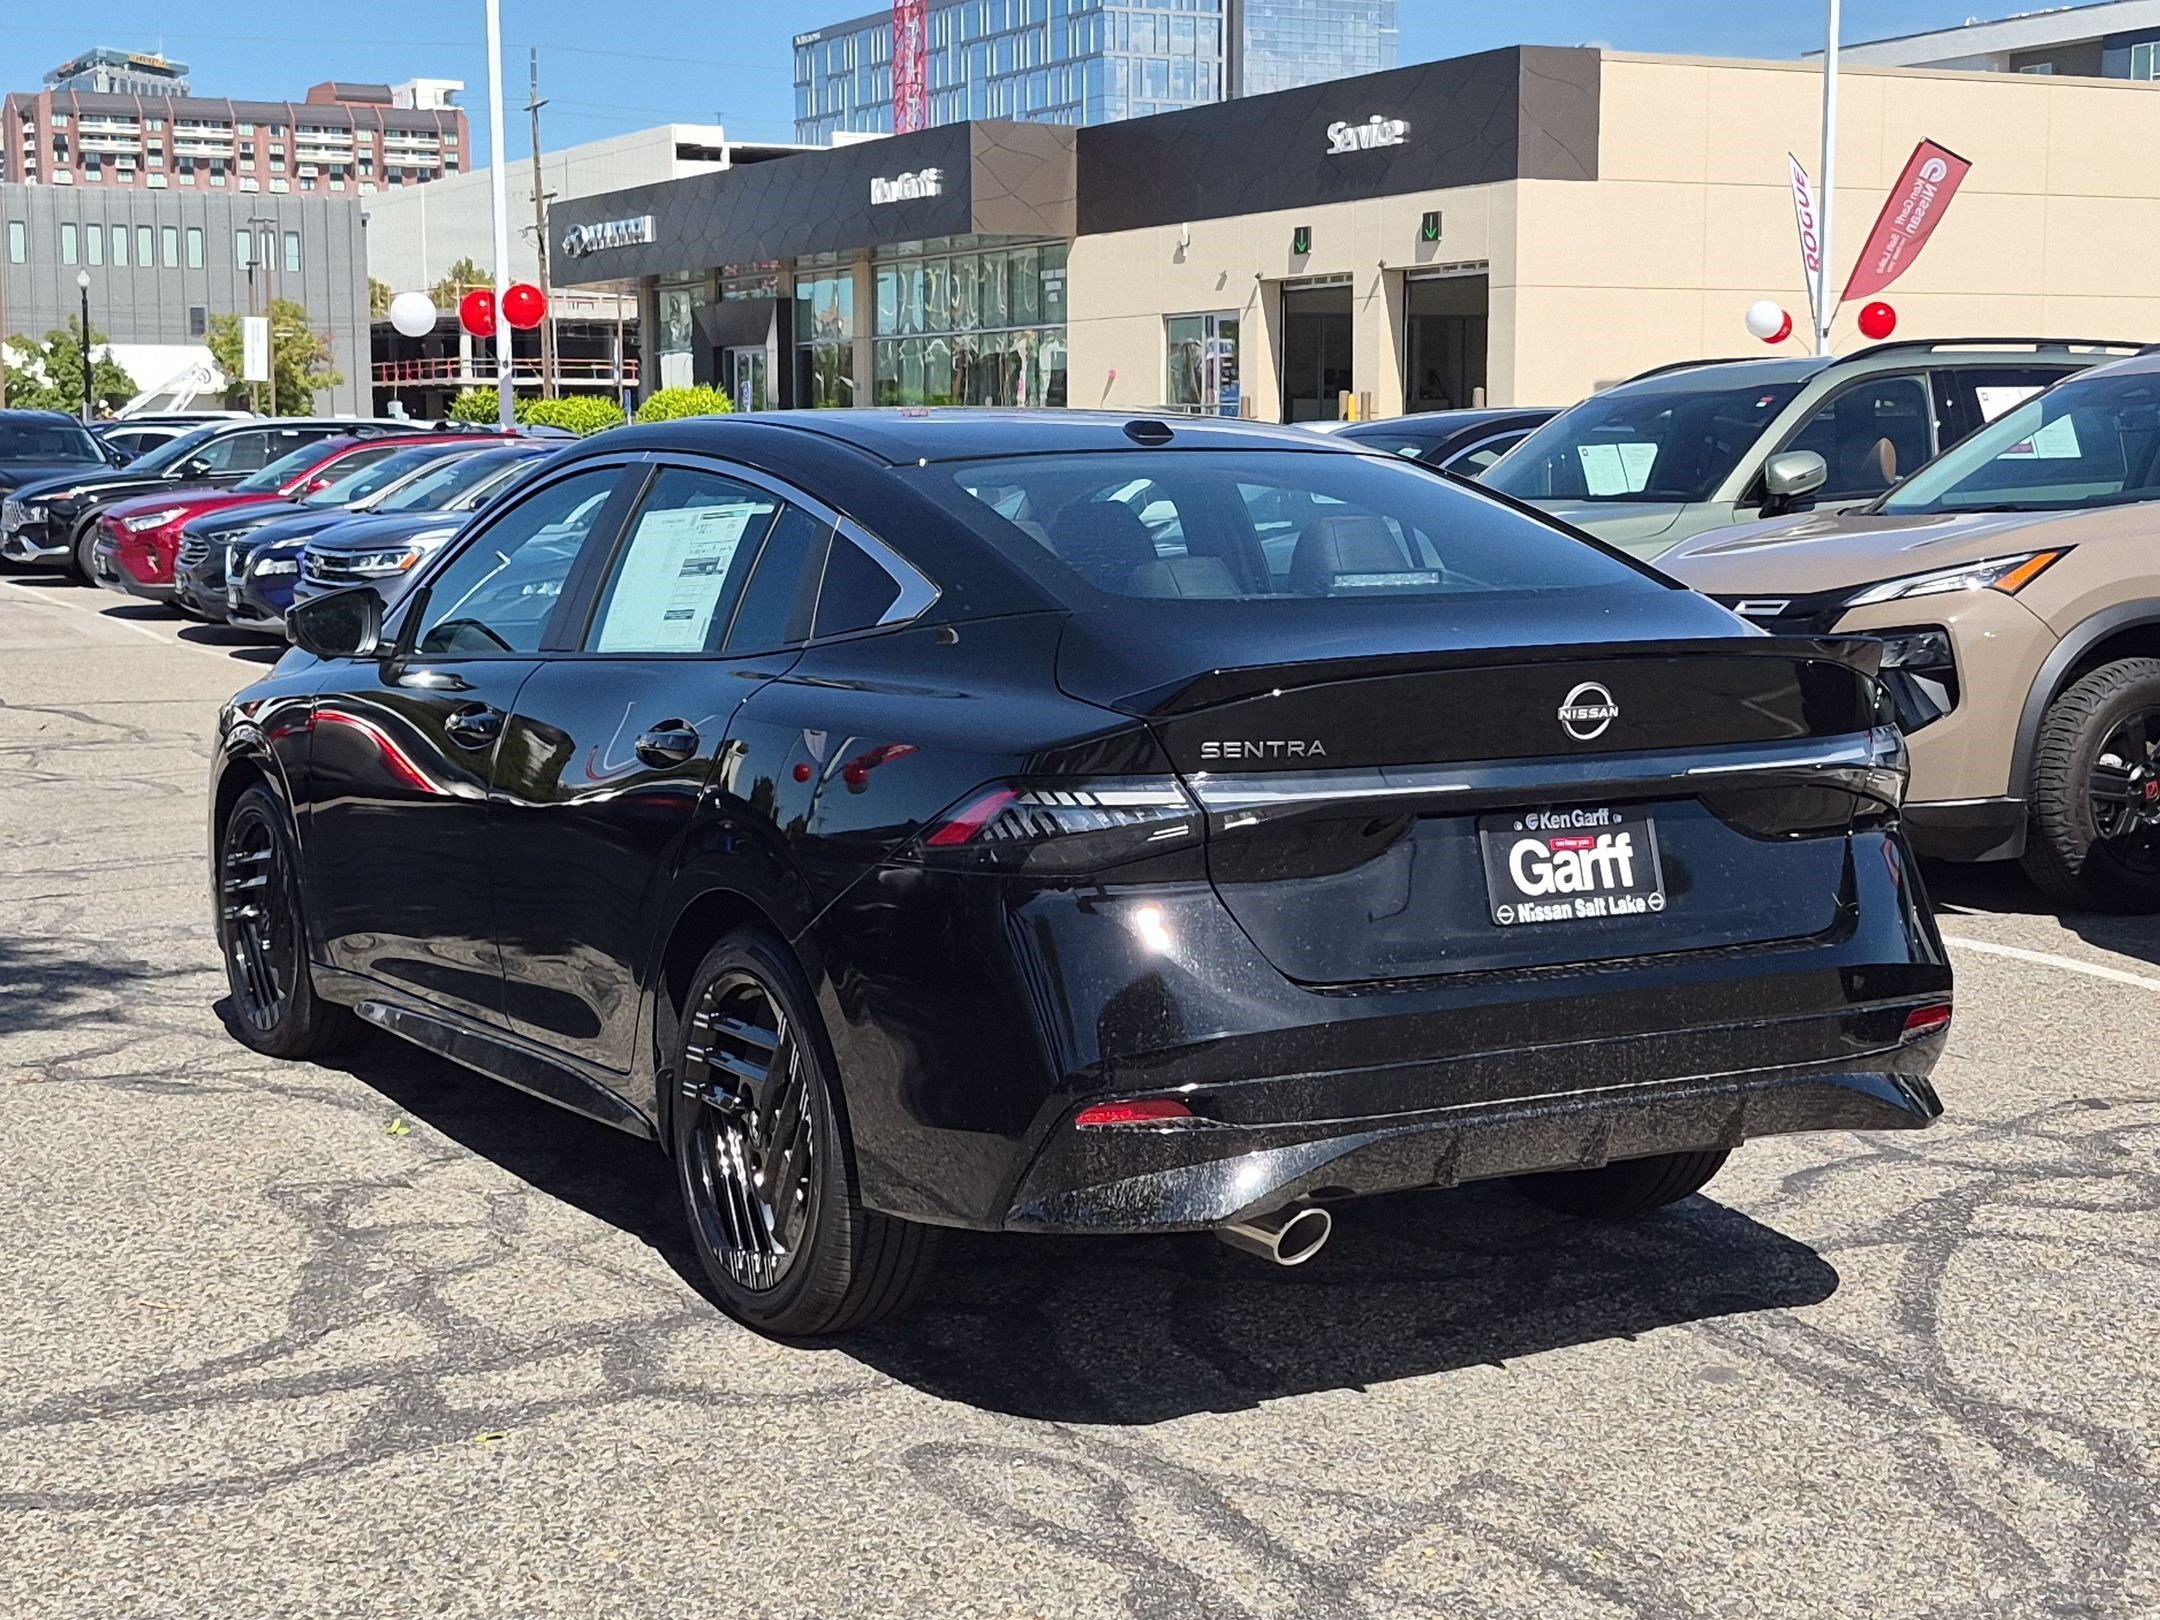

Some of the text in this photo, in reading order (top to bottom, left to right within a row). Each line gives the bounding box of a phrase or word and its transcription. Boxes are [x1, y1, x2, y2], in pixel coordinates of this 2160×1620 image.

[1326, 114, 1409, 155] Service
[1793, 166, 1821, 273] ROGUE
[1559, 706, 1619, 720] NISSAN
[1200, 739, 1327, 760] SENTRA
[1540, 808, 1610, 830] Ken Garff
[1508, 831, 1634, 897] Garff
[1517, 894, 1647, 923] Nissan Salt Lake
